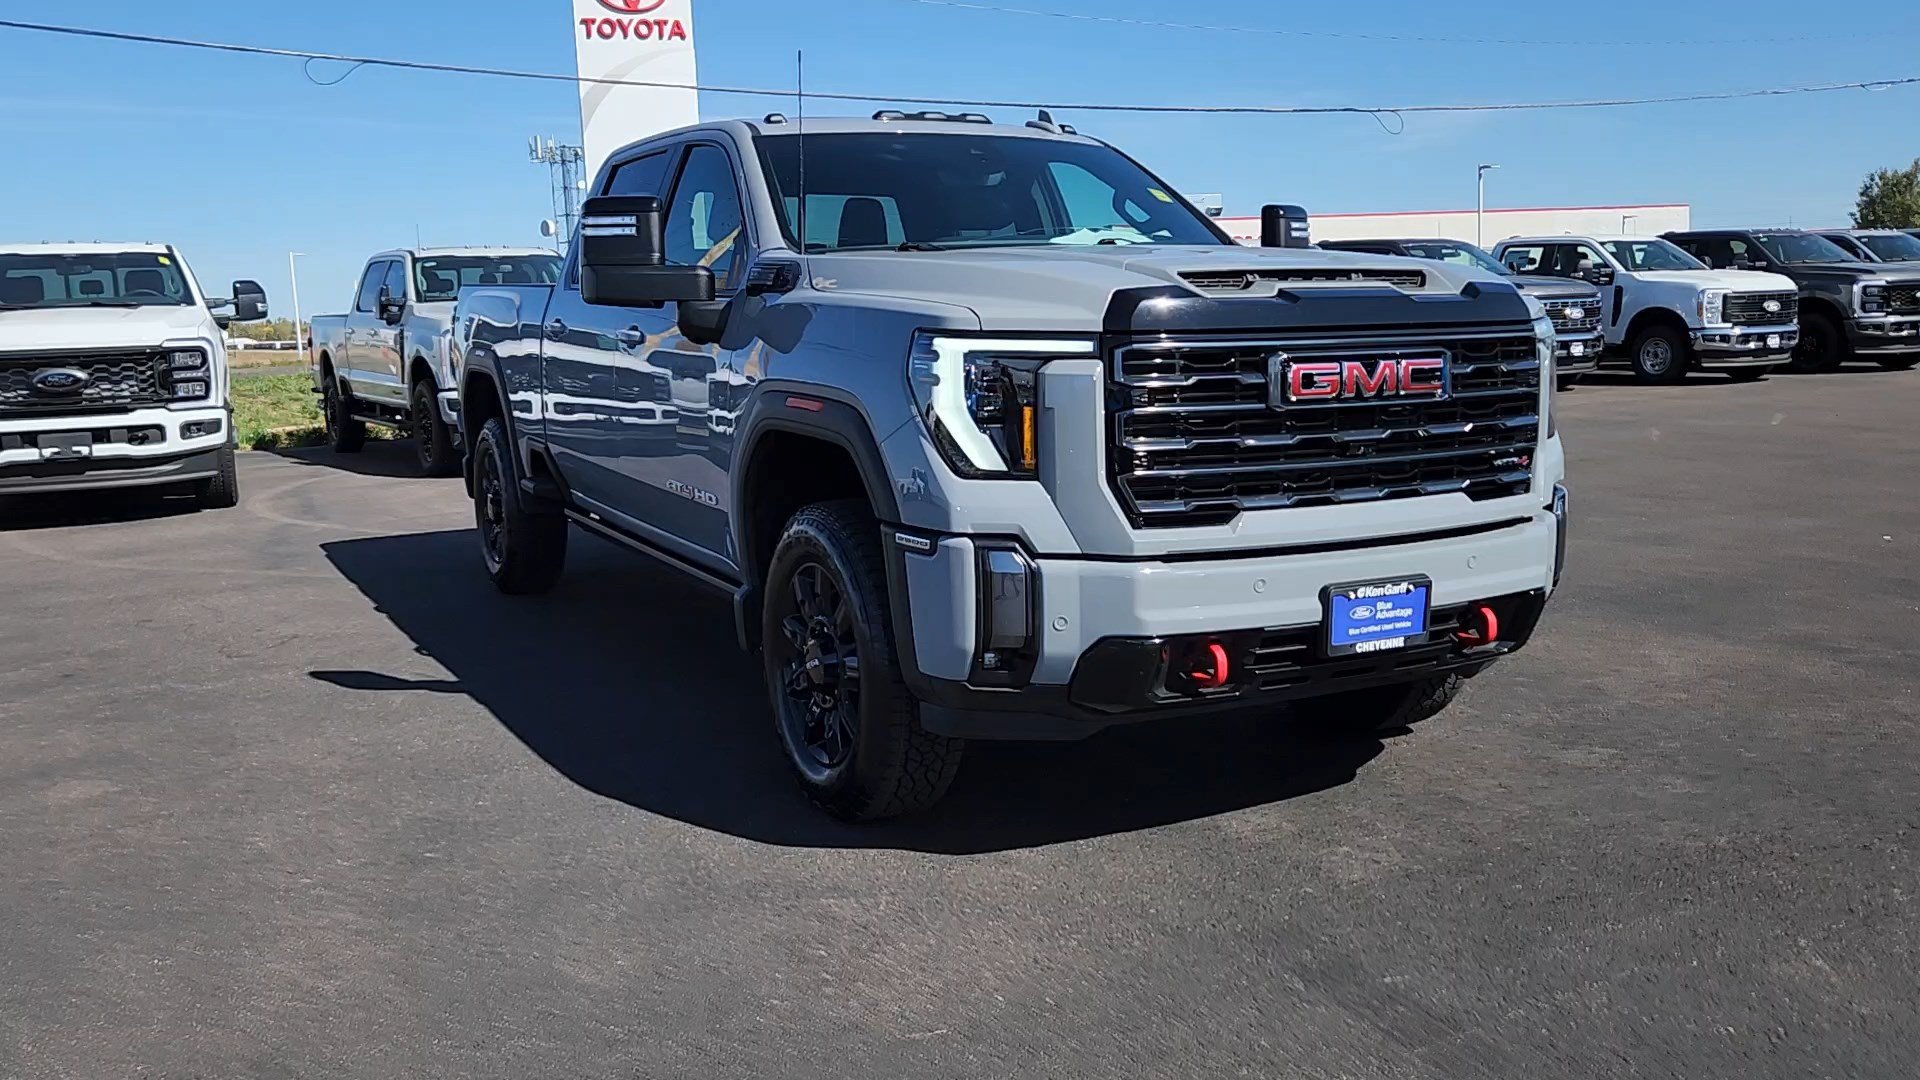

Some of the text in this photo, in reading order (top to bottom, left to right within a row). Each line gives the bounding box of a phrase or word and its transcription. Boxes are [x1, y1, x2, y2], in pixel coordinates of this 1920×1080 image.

[579, 17, 687, 41] TOYOTA
[45, 374, 74, 386] Ford
[1290, 358, 1443, 398] GMC
[1365, 582, 1408, 598] Ken Garff
[1376, 601, 1392, 610] Blue
[1376, 607, 1413, 620] Advantage
[1355, 636, 1405, 653] CHEYENNE
